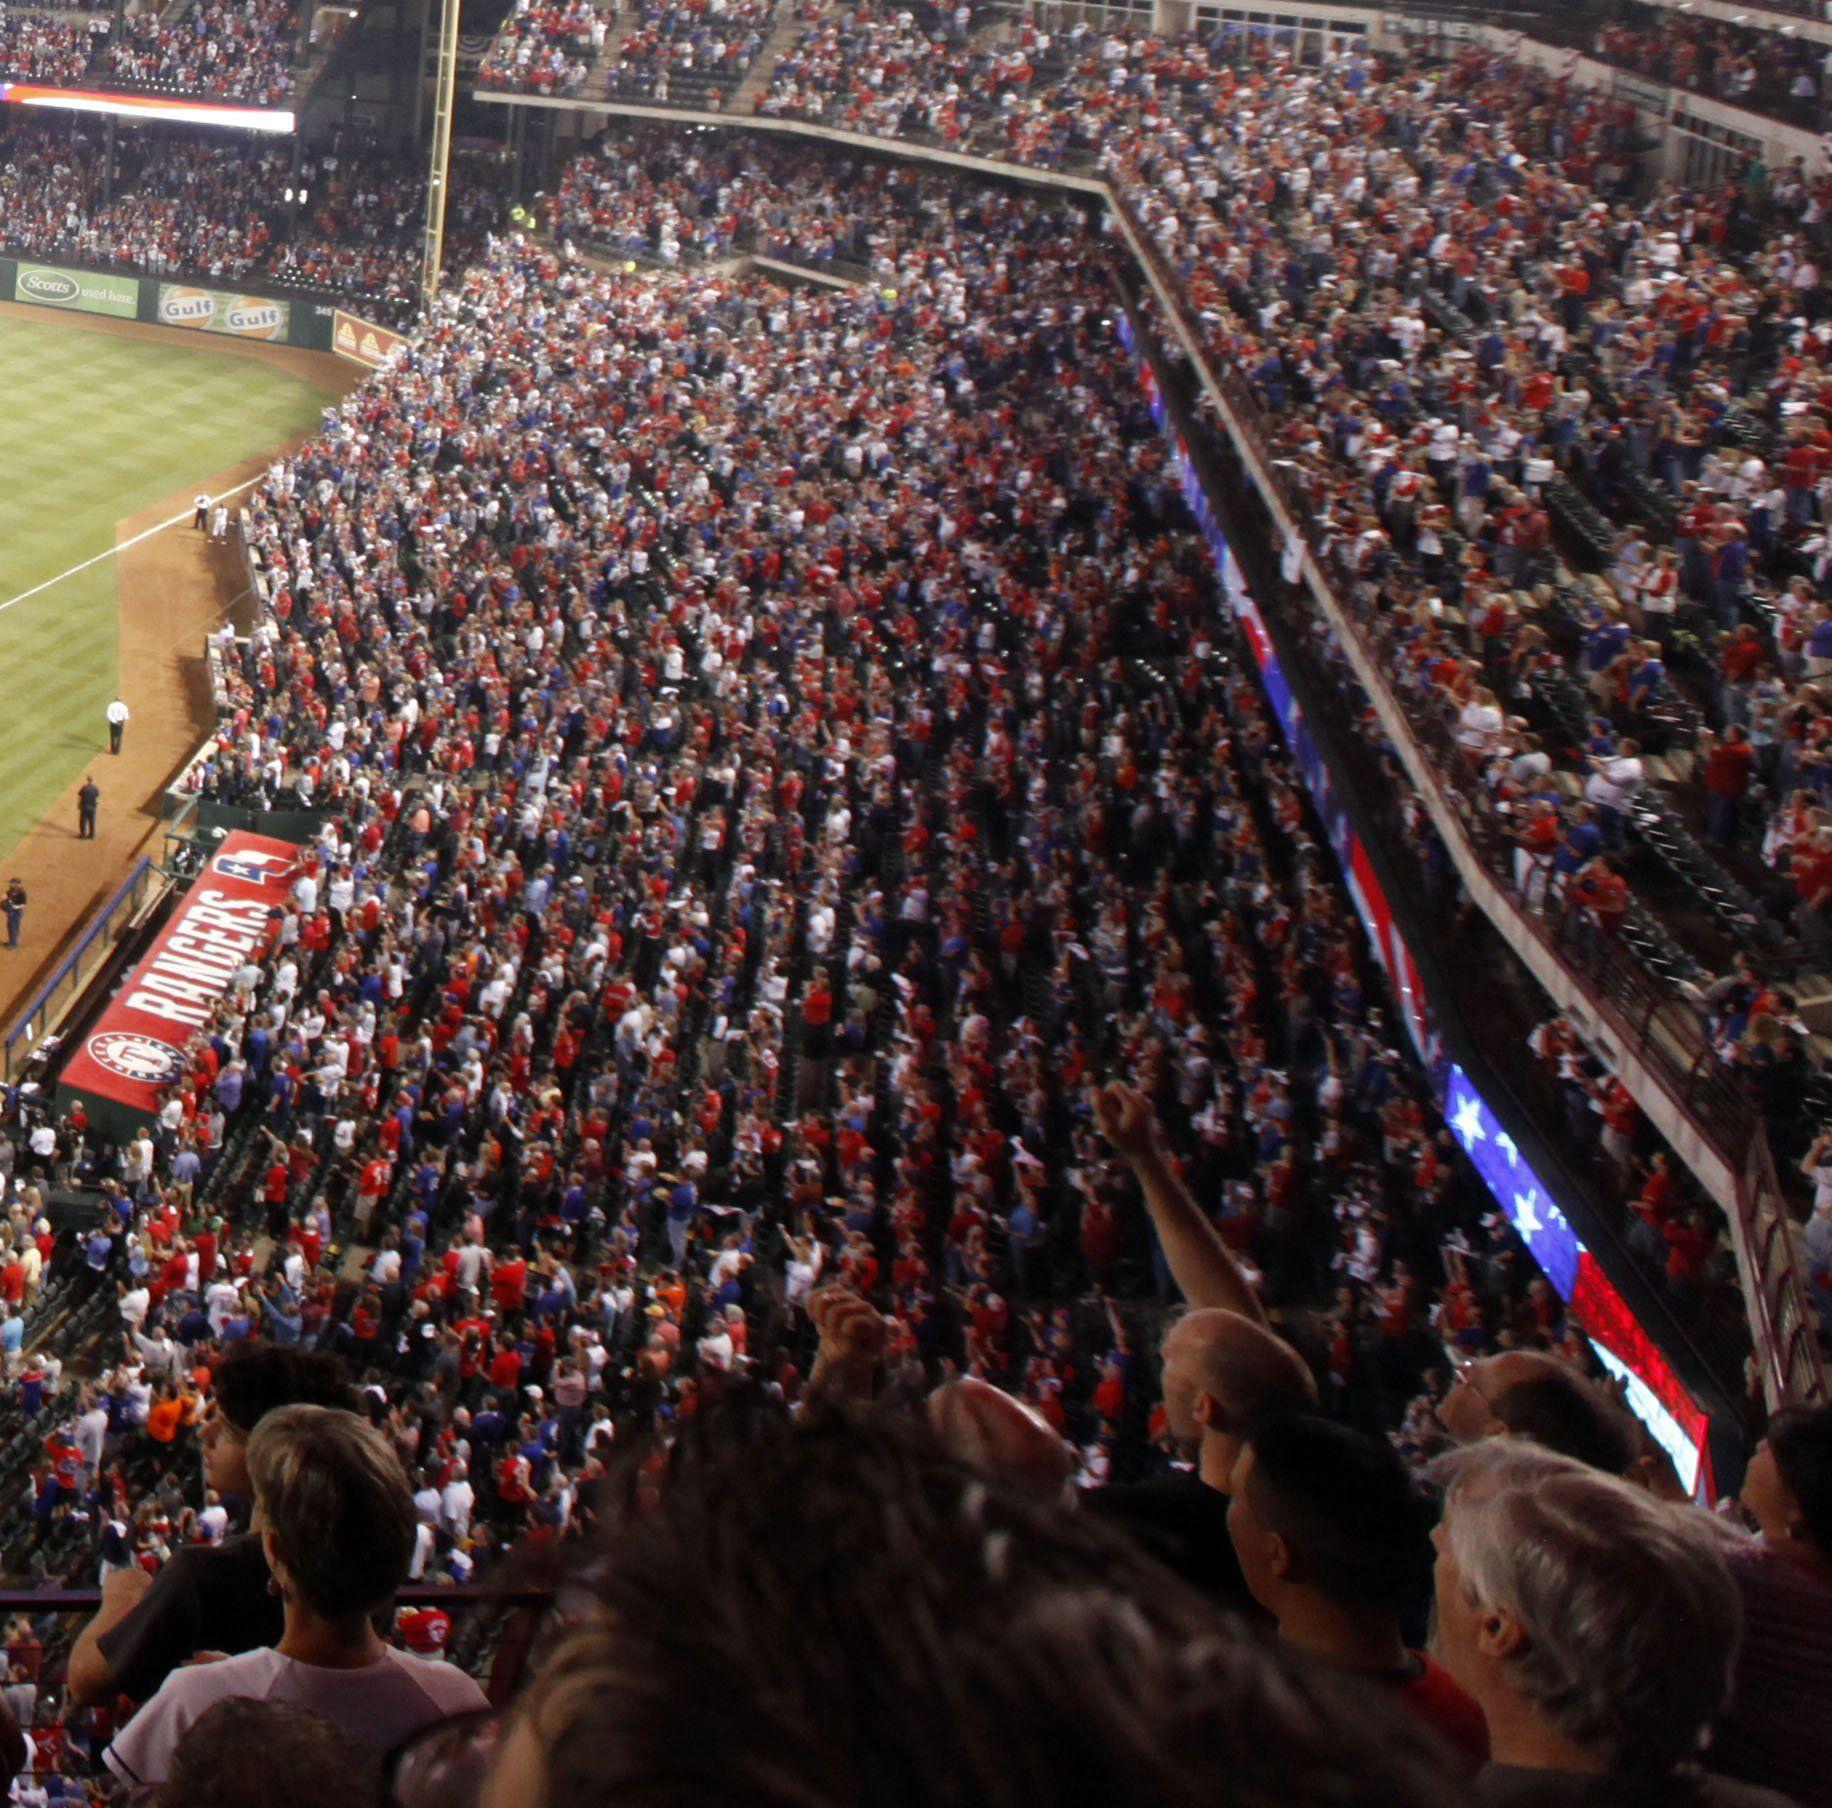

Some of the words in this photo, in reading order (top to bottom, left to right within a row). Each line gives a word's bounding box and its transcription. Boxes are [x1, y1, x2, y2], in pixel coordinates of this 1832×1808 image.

[27, 276, 71, 294] Scotts
[81, 286, 106, 301] used
[165, 299, 215, 317] Gulf
[229, 310, 278, 328] Gulf
[124, 889, 272, 1028] RANGERS
